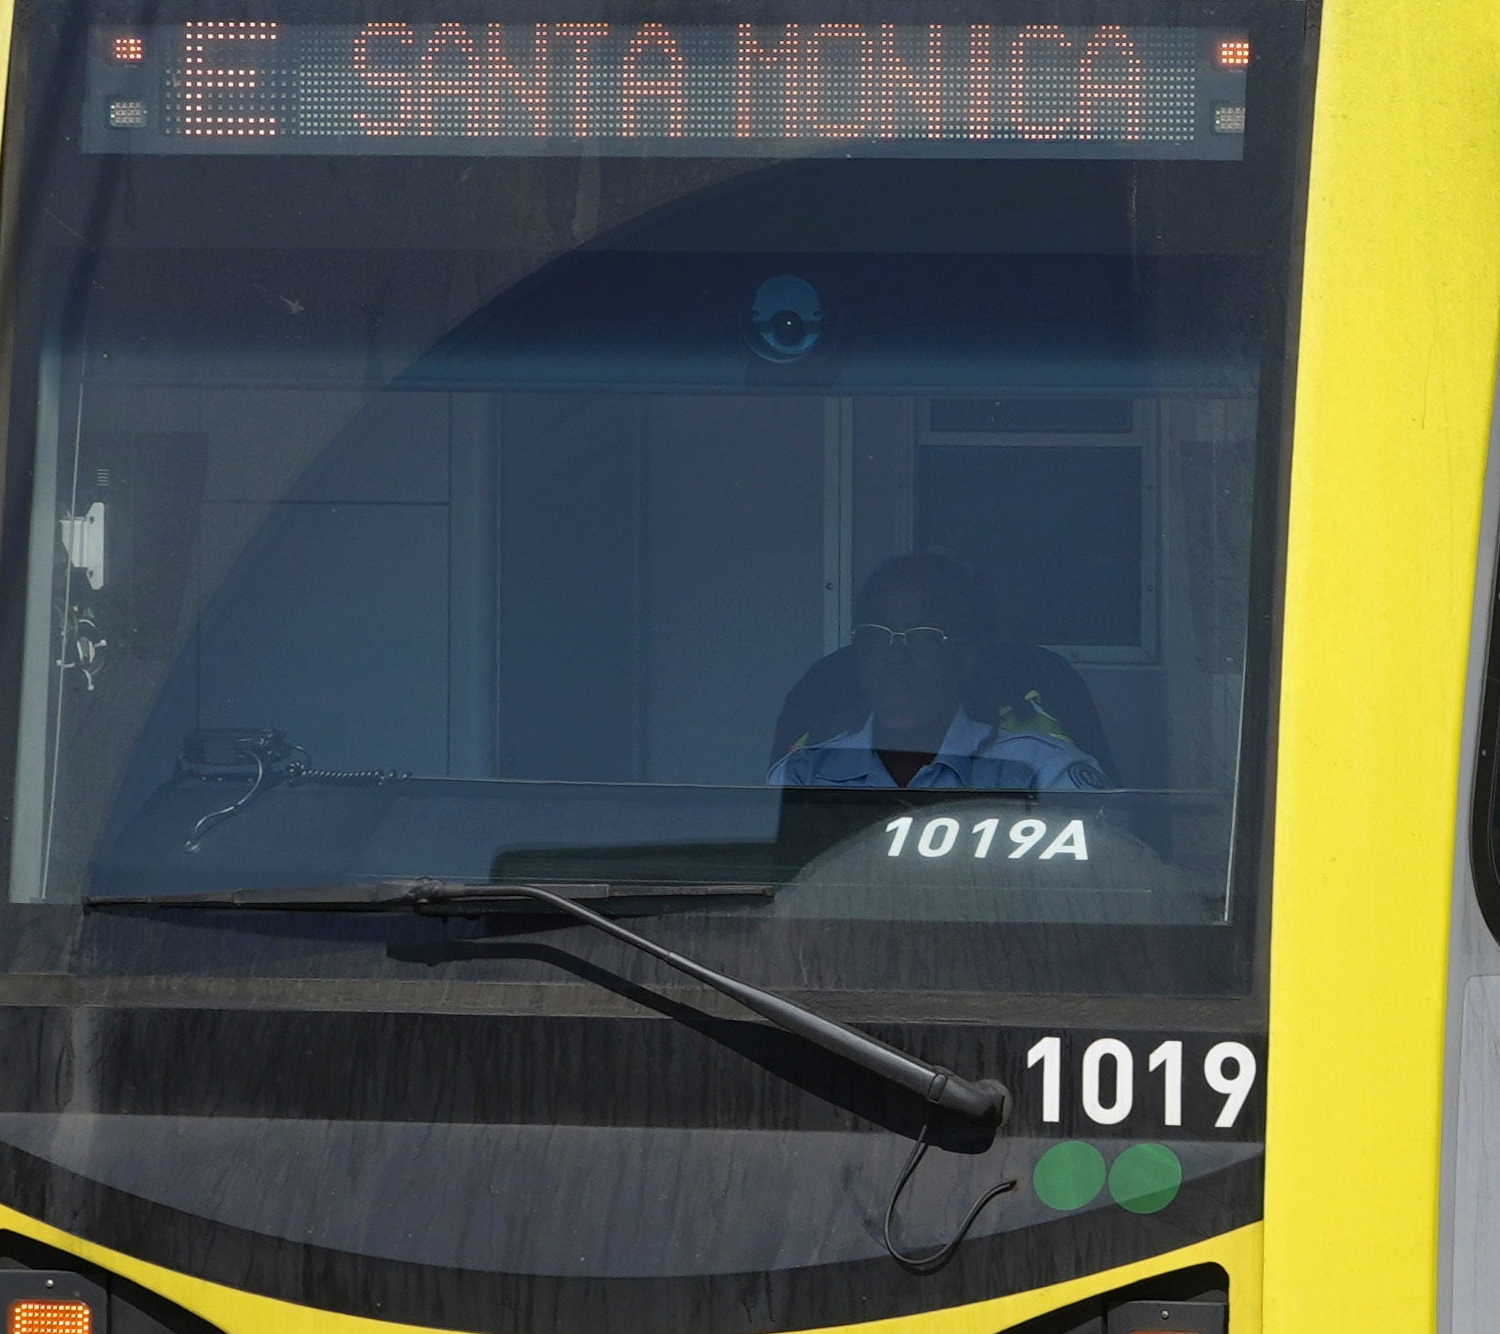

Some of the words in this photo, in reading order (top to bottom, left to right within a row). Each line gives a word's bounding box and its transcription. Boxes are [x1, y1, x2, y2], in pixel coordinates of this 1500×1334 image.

[183, 20, 280, 137] E
[351, 21, 686, 140] SANTA
[735, 21, 1143, 142] MONICA
[884, 816, 1090, 861] 1019A
[1026, 1037, 1257, 1128] 1019
